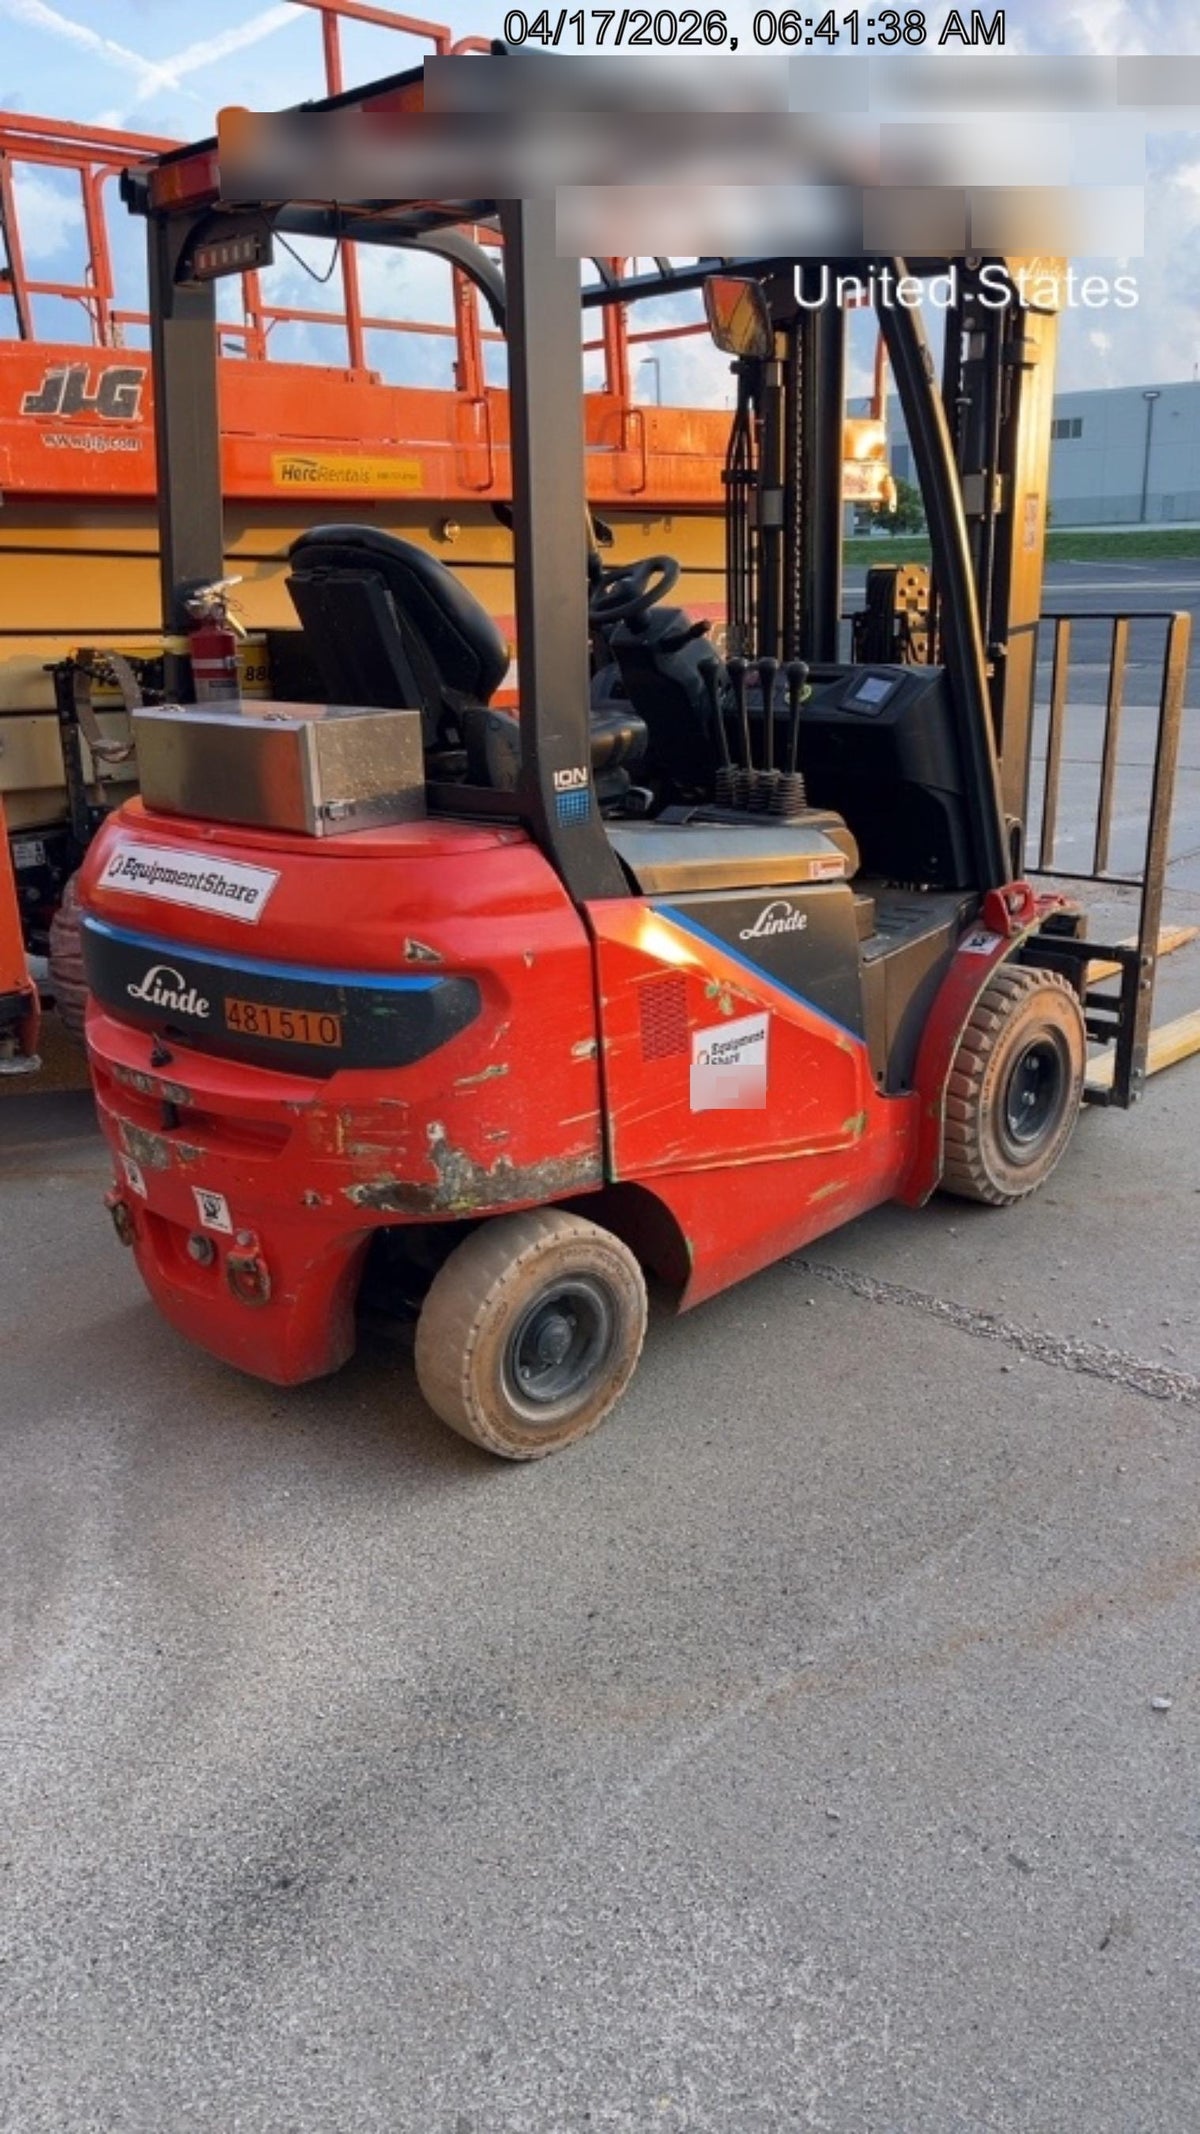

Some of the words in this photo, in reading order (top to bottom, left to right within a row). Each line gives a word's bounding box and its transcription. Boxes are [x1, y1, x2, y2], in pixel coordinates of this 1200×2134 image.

[20, 363, 147, 421] JLG
[553, 766, 588, 785] ION
[121, 857, 260, 904] EquipmentShare
[739, 901, 807, 940] Linde
[127, 964, 211, 1019] Linde
[227, 1002, 338, 1045] 481510
